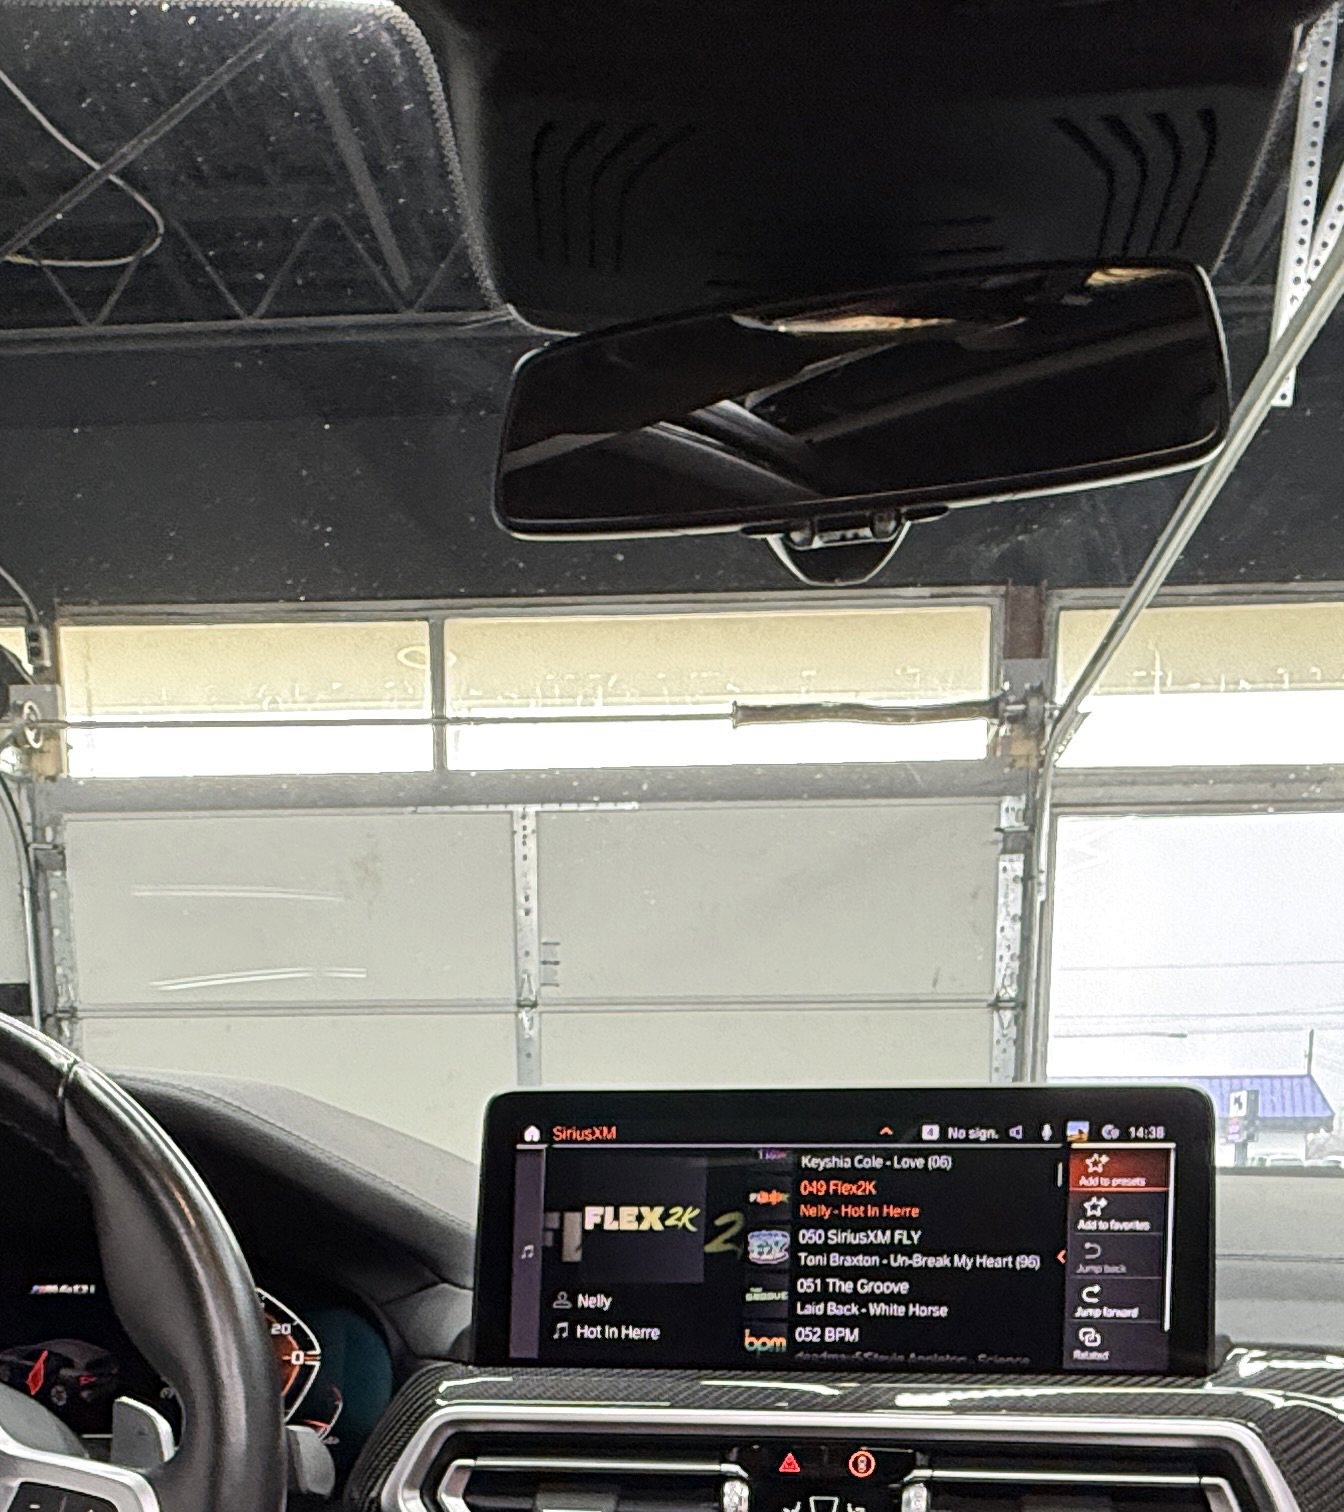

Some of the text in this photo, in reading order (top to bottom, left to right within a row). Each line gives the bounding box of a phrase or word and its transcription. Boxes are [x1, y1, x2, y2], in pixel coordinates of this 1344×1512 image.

[553, 1126, 617, 1141] SiriusXM
[948, 1127, 999, 1142] No sign.
[1128, 1126, 1165, 1140] 14:38
[801, 1155, 852, 1171] Keyshia
[854, 1155, 884, 1168] Cole
[893, 1156, 925, 1169] Love
[800, 1181, 877, 1196] 049 Flex2K
[1079, 1176, 1098, 1187] Add
[1100, 1177, 1110, 1187] to
[584, 1206, 701, 1232] FLEX 2K
[800, 1205, 832, 1220] Nelly
[841, 1205, 866, 1218] Hot
[867, 1205, 879, 1217] In
[882, 1205, 920, 1218] Herre
[1077, 1220, 1097, 1231] Add
[1098, 1220, 1110, 1231] to
[798, 1230, 922, 1245] 050 SiriusXM FLY
[798, 1253, 827, 1267] Toni
[829, 1253, 880, 1267] Braxton
[889, 1253, 951, 1268] Un-Break
[953, 1255, 974, 1271] My
[975, 1255, 1013, 1269] Heart
[796, 1278, 909, 1294] 051 The Groove
[577, 1293, 612, 1311] Nelly
[796, 1302, 825, 1316] Laid
[827, 1302, 860, 1316] Back
[868, 1303, 906, 1317] White
[908, 1303, 949, 1318] Horse
[271, 1323, 292, 1335] 20
[577, 1325, 661, 1340] Hot In Herre
[795, 1328, 860, 1342] 052 BPM
[291, 1350, 304, 1365] 0
